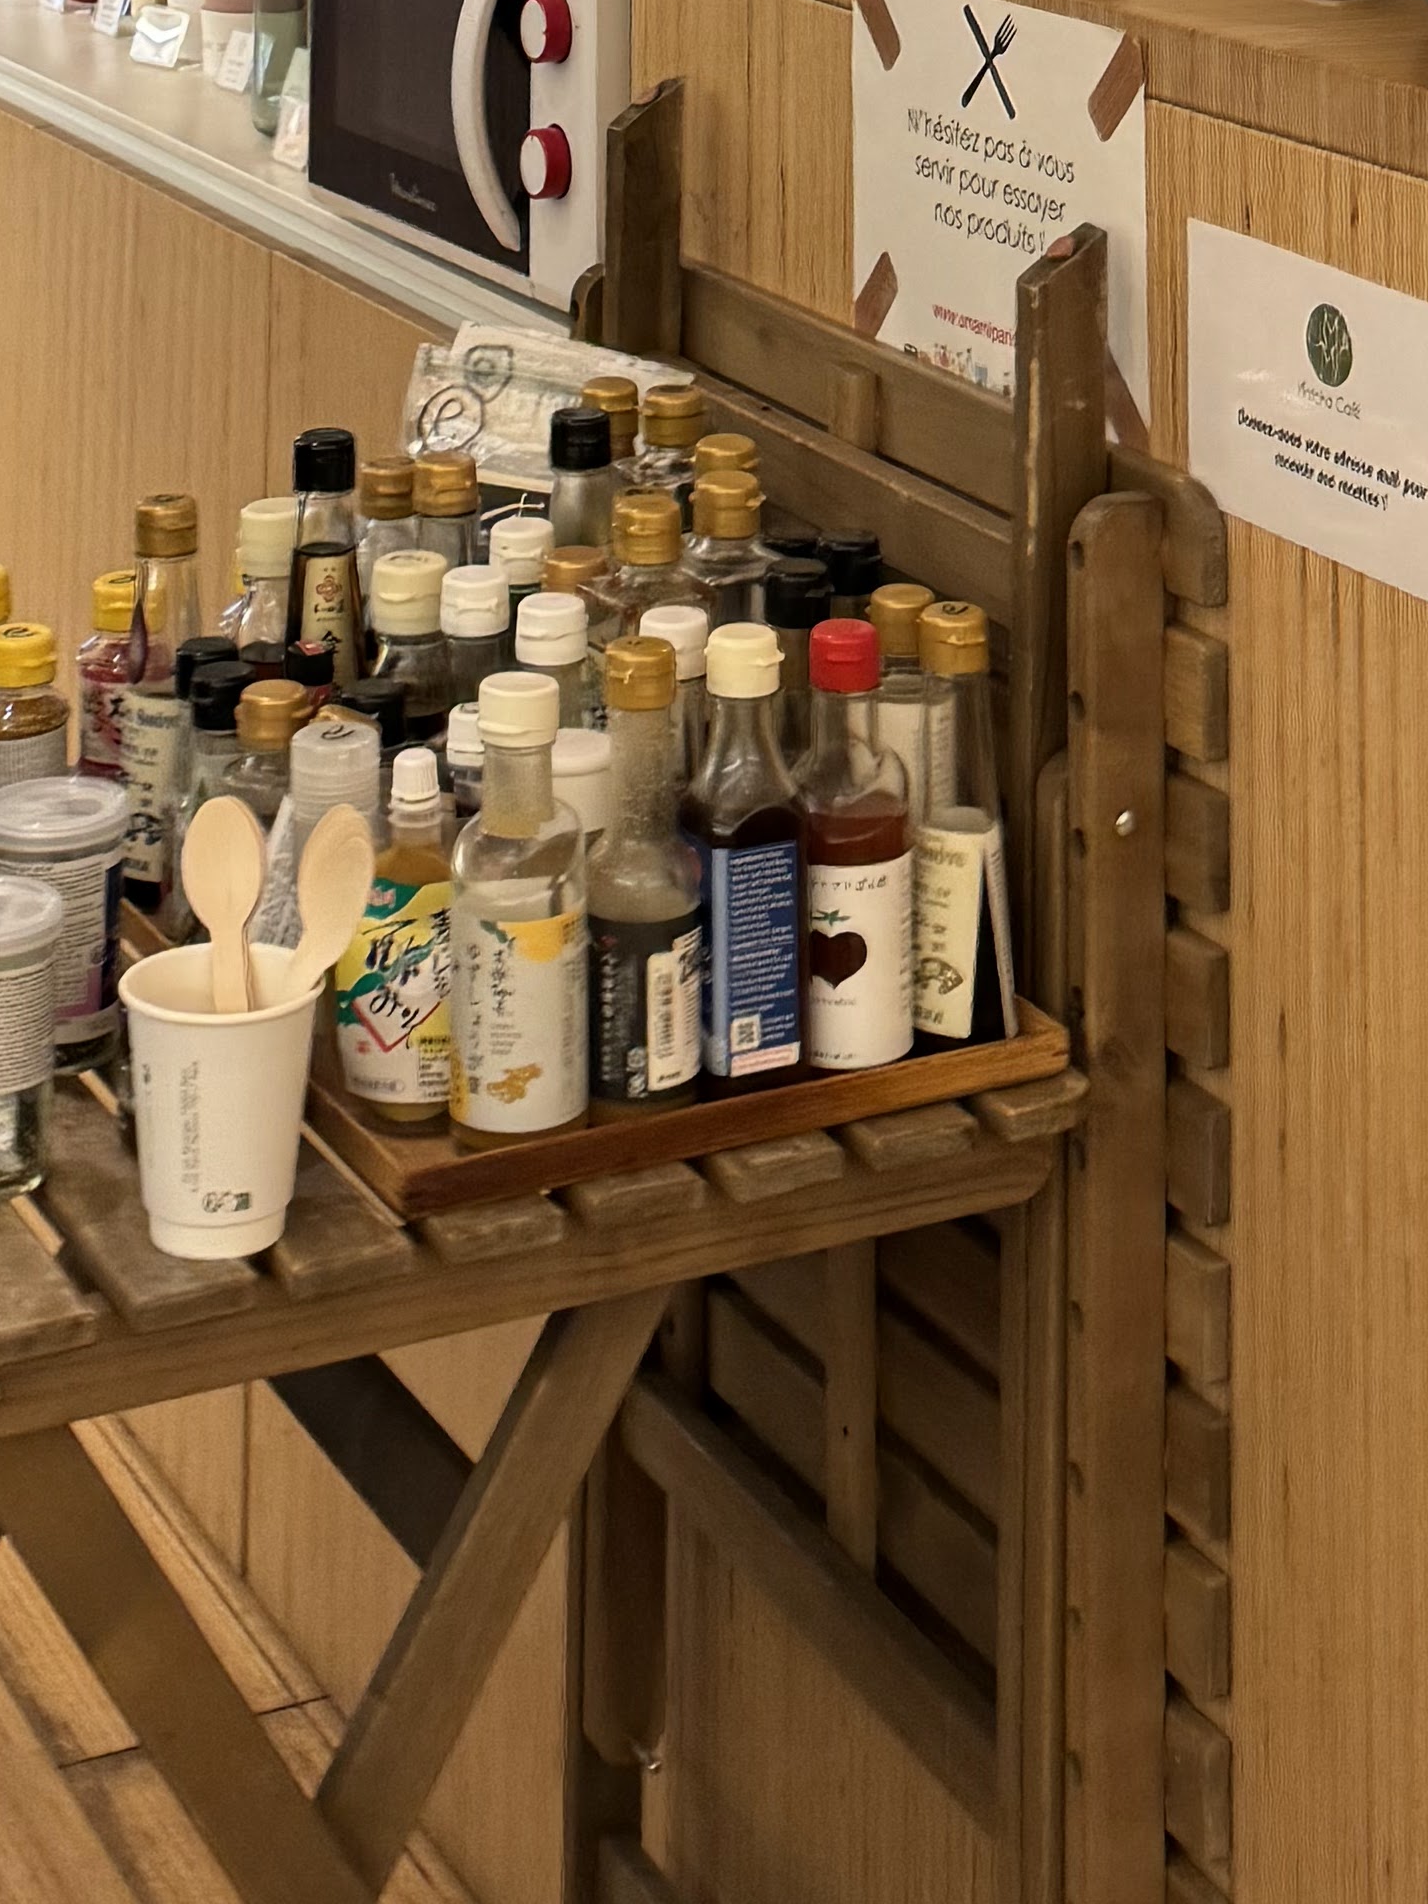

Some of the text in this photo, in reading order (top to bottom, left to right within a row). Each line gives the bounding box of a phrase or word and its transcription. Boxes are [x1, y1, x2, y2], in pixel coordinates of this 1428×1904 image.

[907, 108, 1075, 183] N'hésitez pas à vous
[915, 153, 1067, 223] servir pour essayer
[934, 201, 963, 230] nos
[967, 212, 1036, 255] produits
